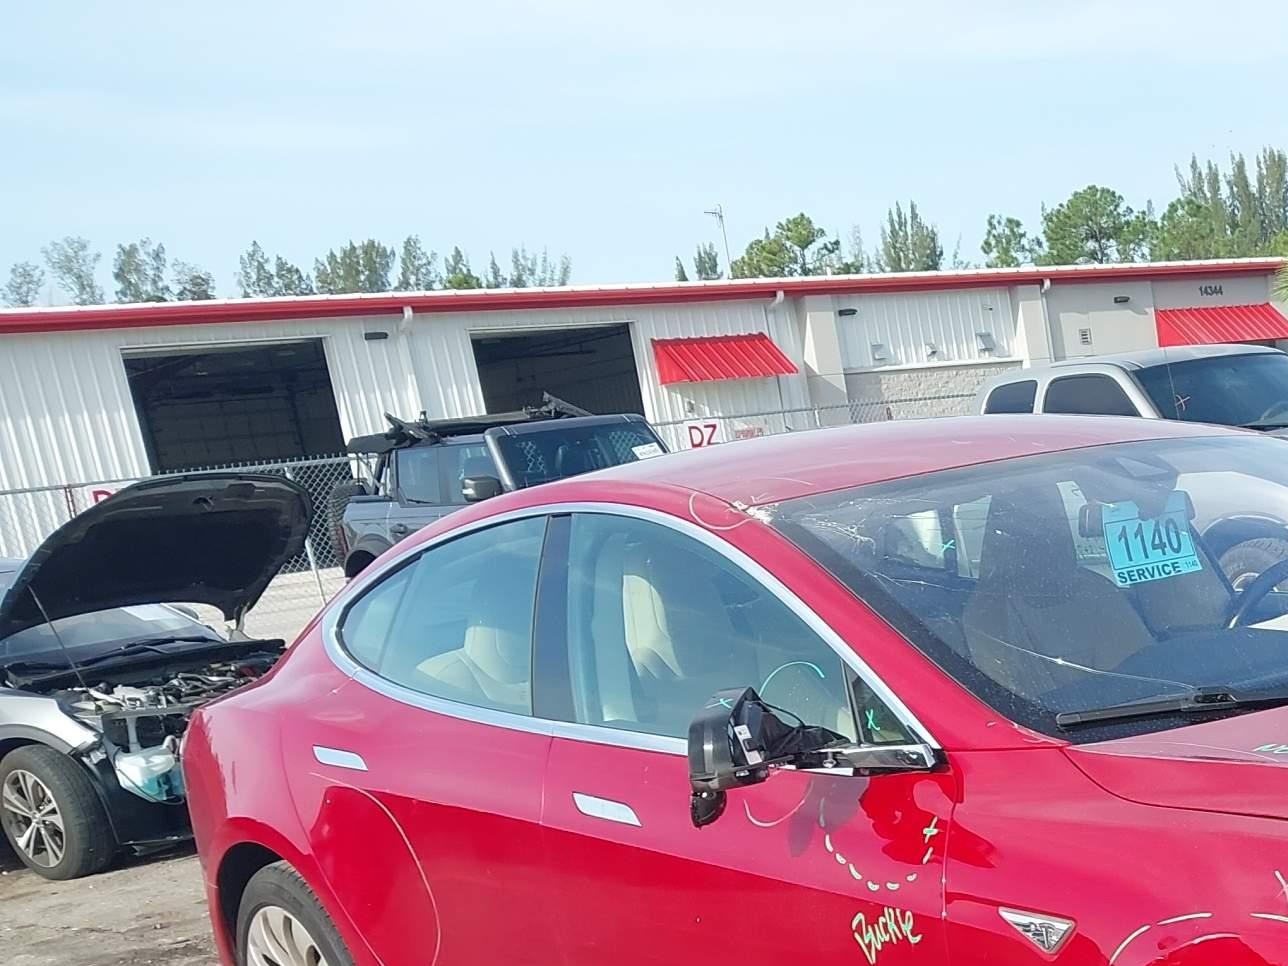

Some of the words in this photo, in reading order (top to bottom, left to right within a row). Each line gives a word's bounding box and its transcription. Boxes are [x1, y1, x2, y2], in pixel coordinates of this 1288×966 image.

[1199, 284, 1224, 297] 14344
[688, 423, 721, 449] DZ
[1118, 518, 1182, 562] 1140
[1117, 561, 1182, 584] SERVICE
